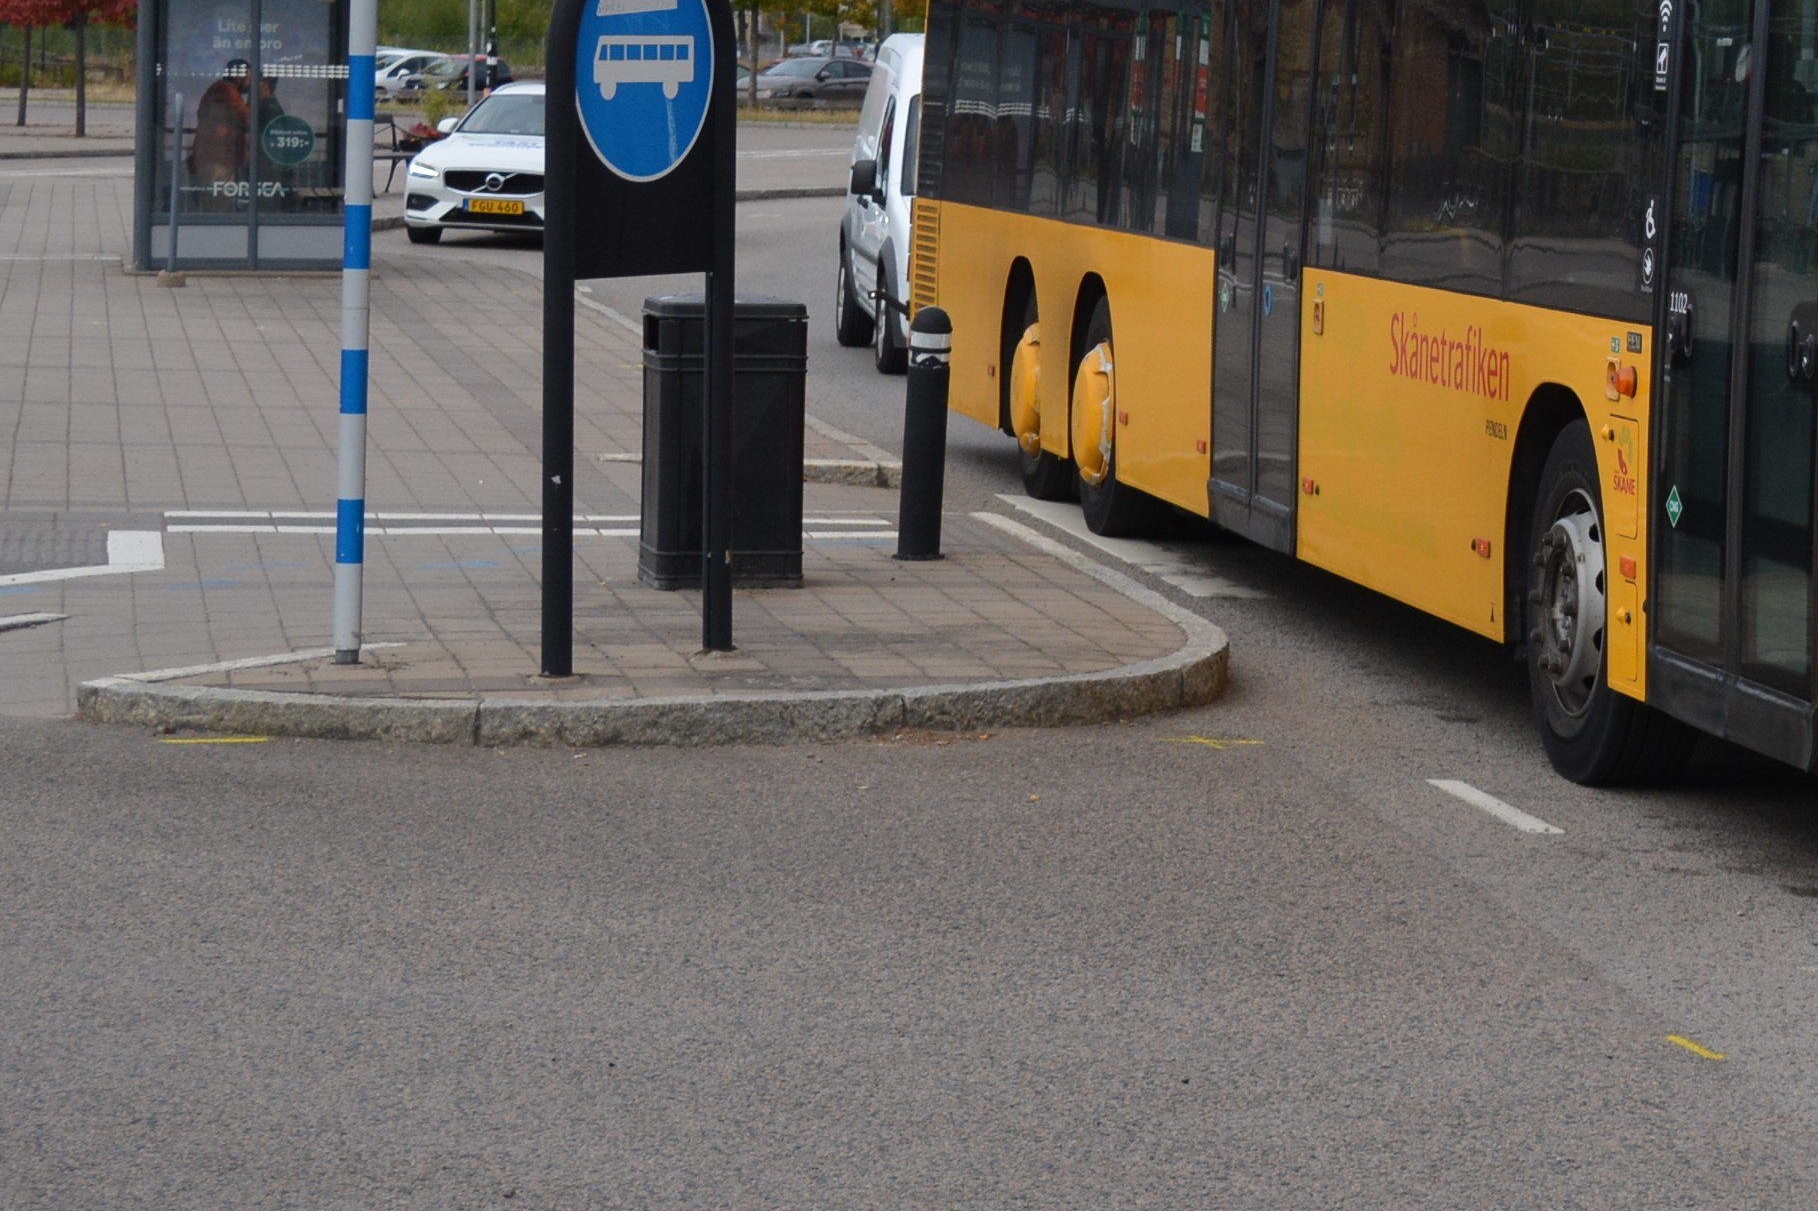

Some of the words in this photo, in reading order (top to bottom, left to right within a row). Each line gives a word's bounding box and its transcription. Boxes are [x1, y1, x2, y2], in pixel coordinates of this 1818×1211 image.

[472, 201, 494, 211] FGU
[496, 202, 519, 213] 460
[1670, 291, 1688, 315] 1102
[1389, 311, 1510, 402] Skånetrafiken
